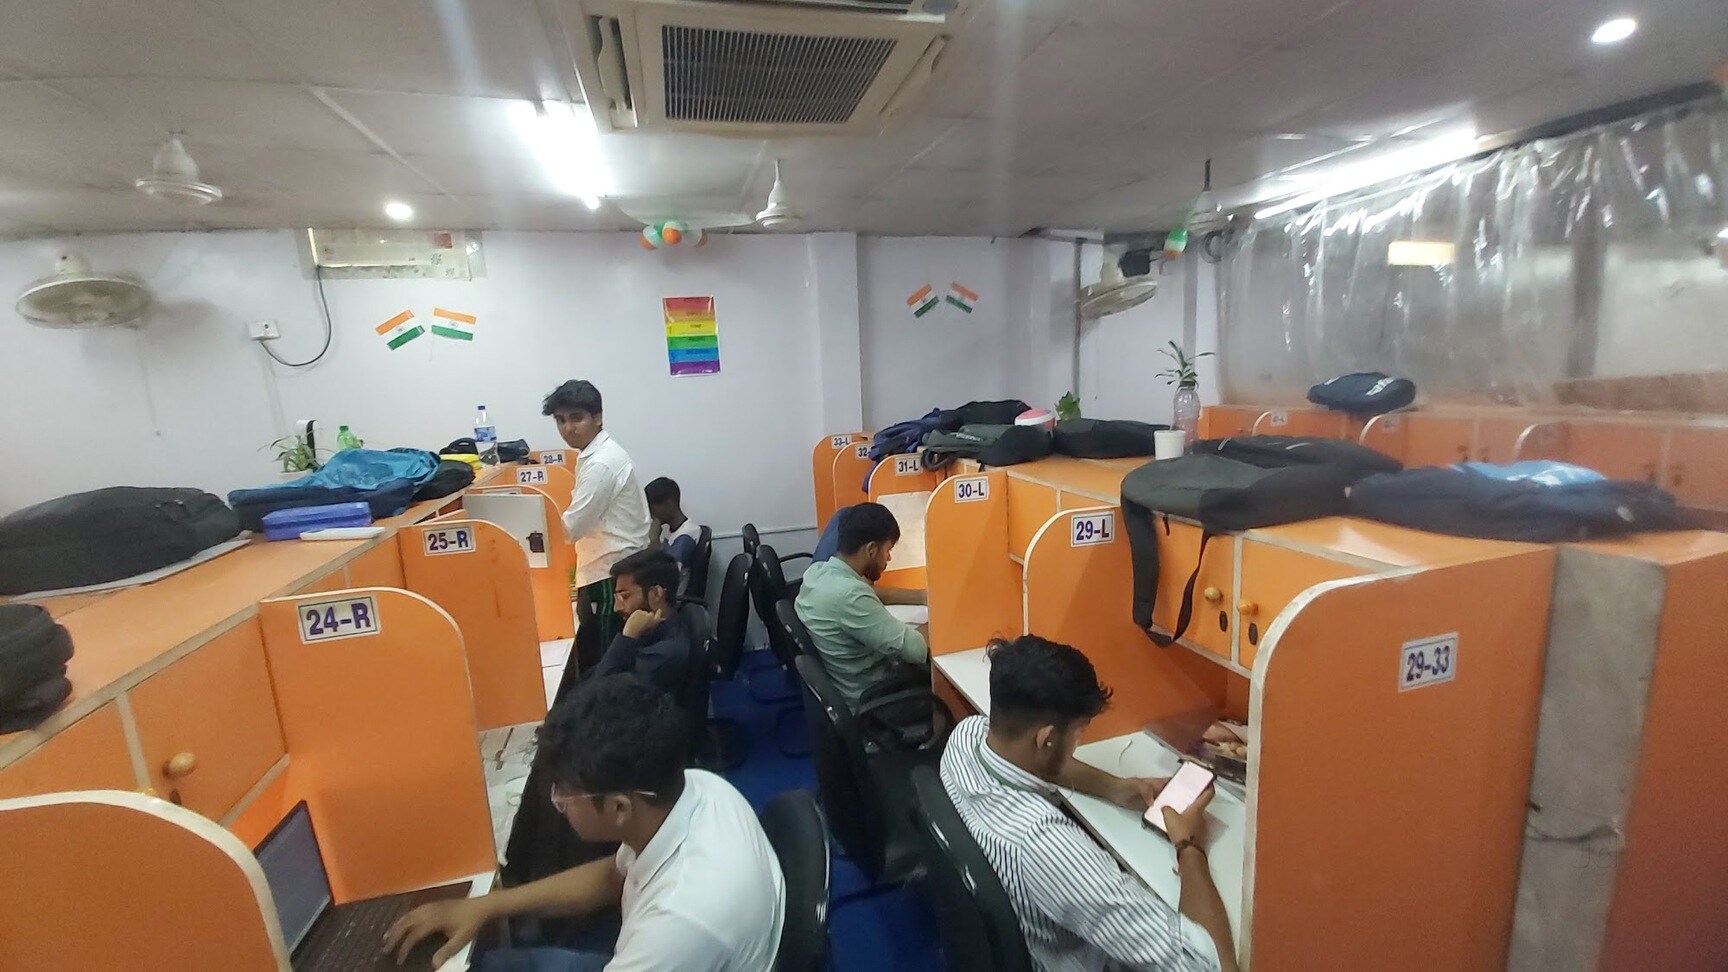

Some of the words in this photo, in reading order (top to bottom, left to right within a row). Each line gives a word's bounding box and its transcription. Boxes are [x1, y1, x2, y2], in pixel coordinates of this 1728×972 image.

[520, 471, 544, 482] 27-R
[898, 460, 919, 473] 31-L
[958, 482, 984, 499] 30-L
[1076, 518, 1110, 541] 29-L
[427, 530, 469, 551] 25-R
[306, 602, 371, 635] 24-R
[1406, 645, 1450, 682] 29-33
